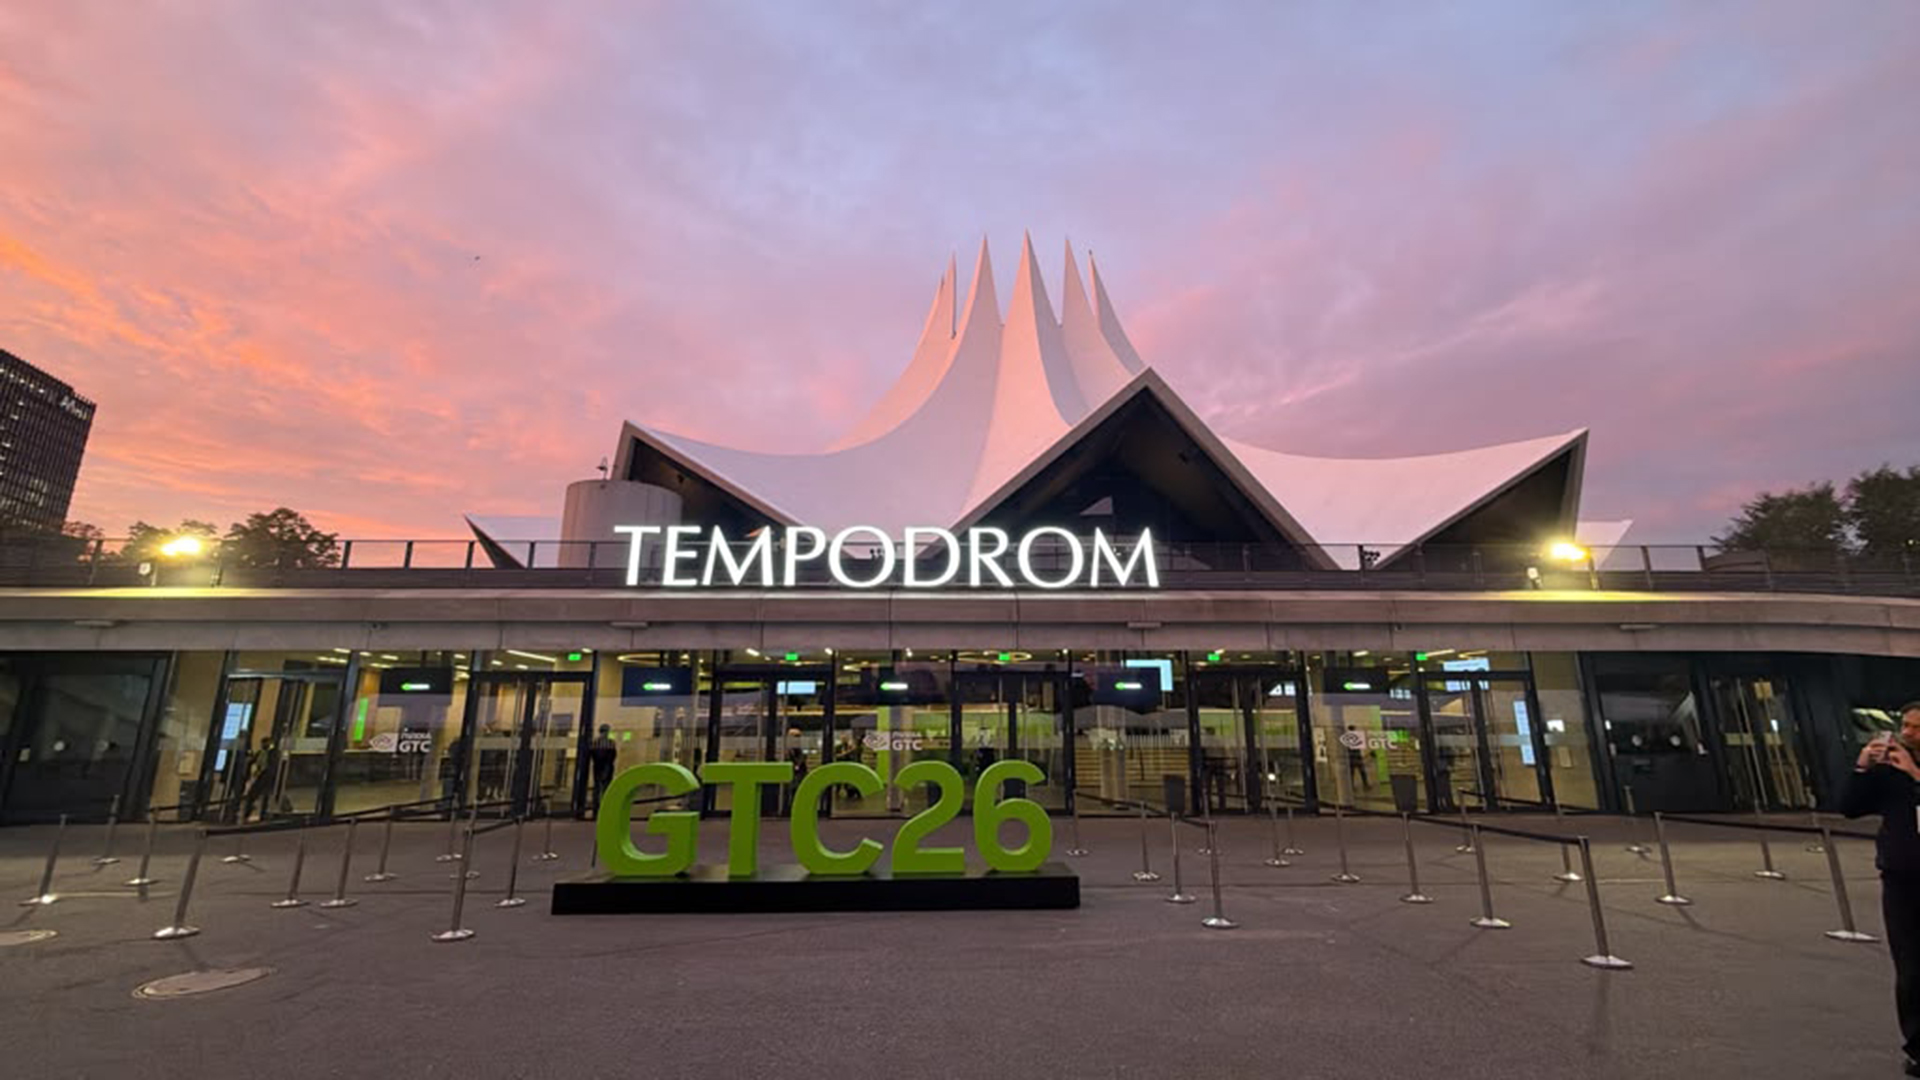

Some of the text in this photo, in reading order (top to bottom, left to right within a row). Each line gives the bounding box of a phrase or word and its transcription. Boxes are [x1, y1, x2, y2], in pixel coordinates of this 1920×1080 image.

[613, 524, 1160, 589] TEMPODROM
[399, 740, 431, 752] GTC
[892, 739, 922, 751] GTC
[597, 760, 1052, 876] GTC26
